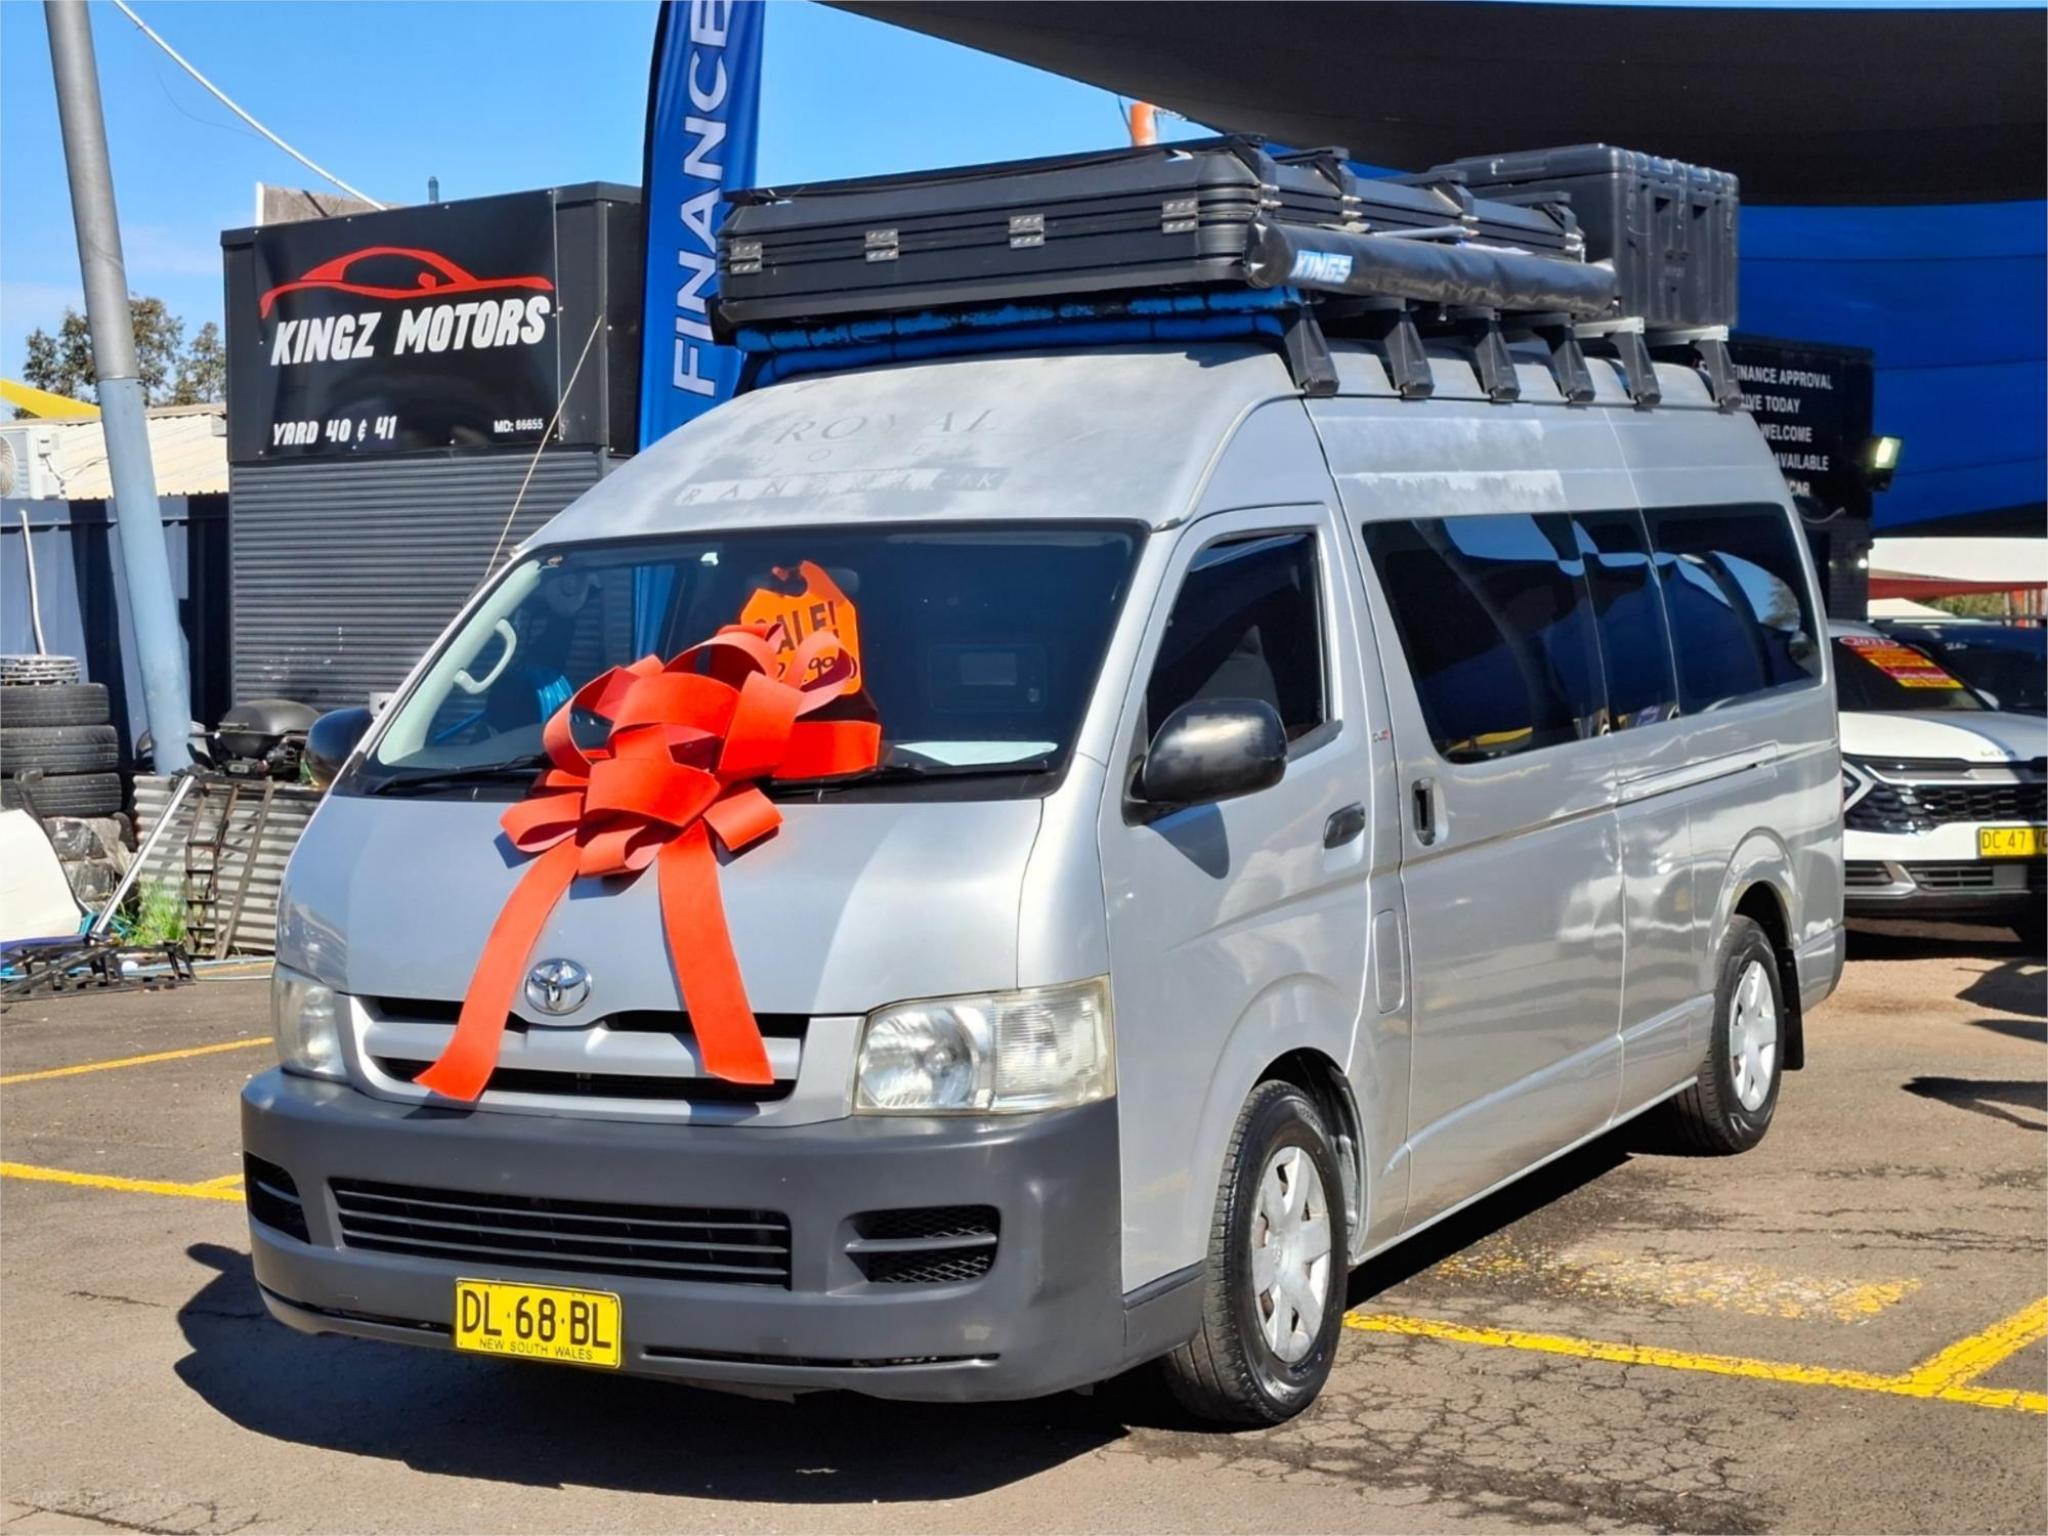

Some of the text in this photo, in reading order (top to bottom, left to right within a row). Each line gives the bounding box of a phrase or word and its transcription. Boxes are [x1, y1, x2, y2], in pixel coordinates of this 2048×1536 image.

[672, 0, 734, 396] FINANCE
[1288, 249, 1353, 283] KINGS
[270, 296, 550, 366] KINGZ MOTORS
[1779, 369, 1834, 390] APPROVAL
[1765, 395, 1801, 414] TODAY
[272, 421, 318, 446] YARD
[325, 419, 351, 442] 40
[374, 415, 398, 440] 41
[493, 419, 514, 433] MD:
[1760, 423, 1813, 442] WELCOME
[755, 601, 840, 654] ALE!
[479, 1338, 593, 1361] NEW SOUTH WALES
